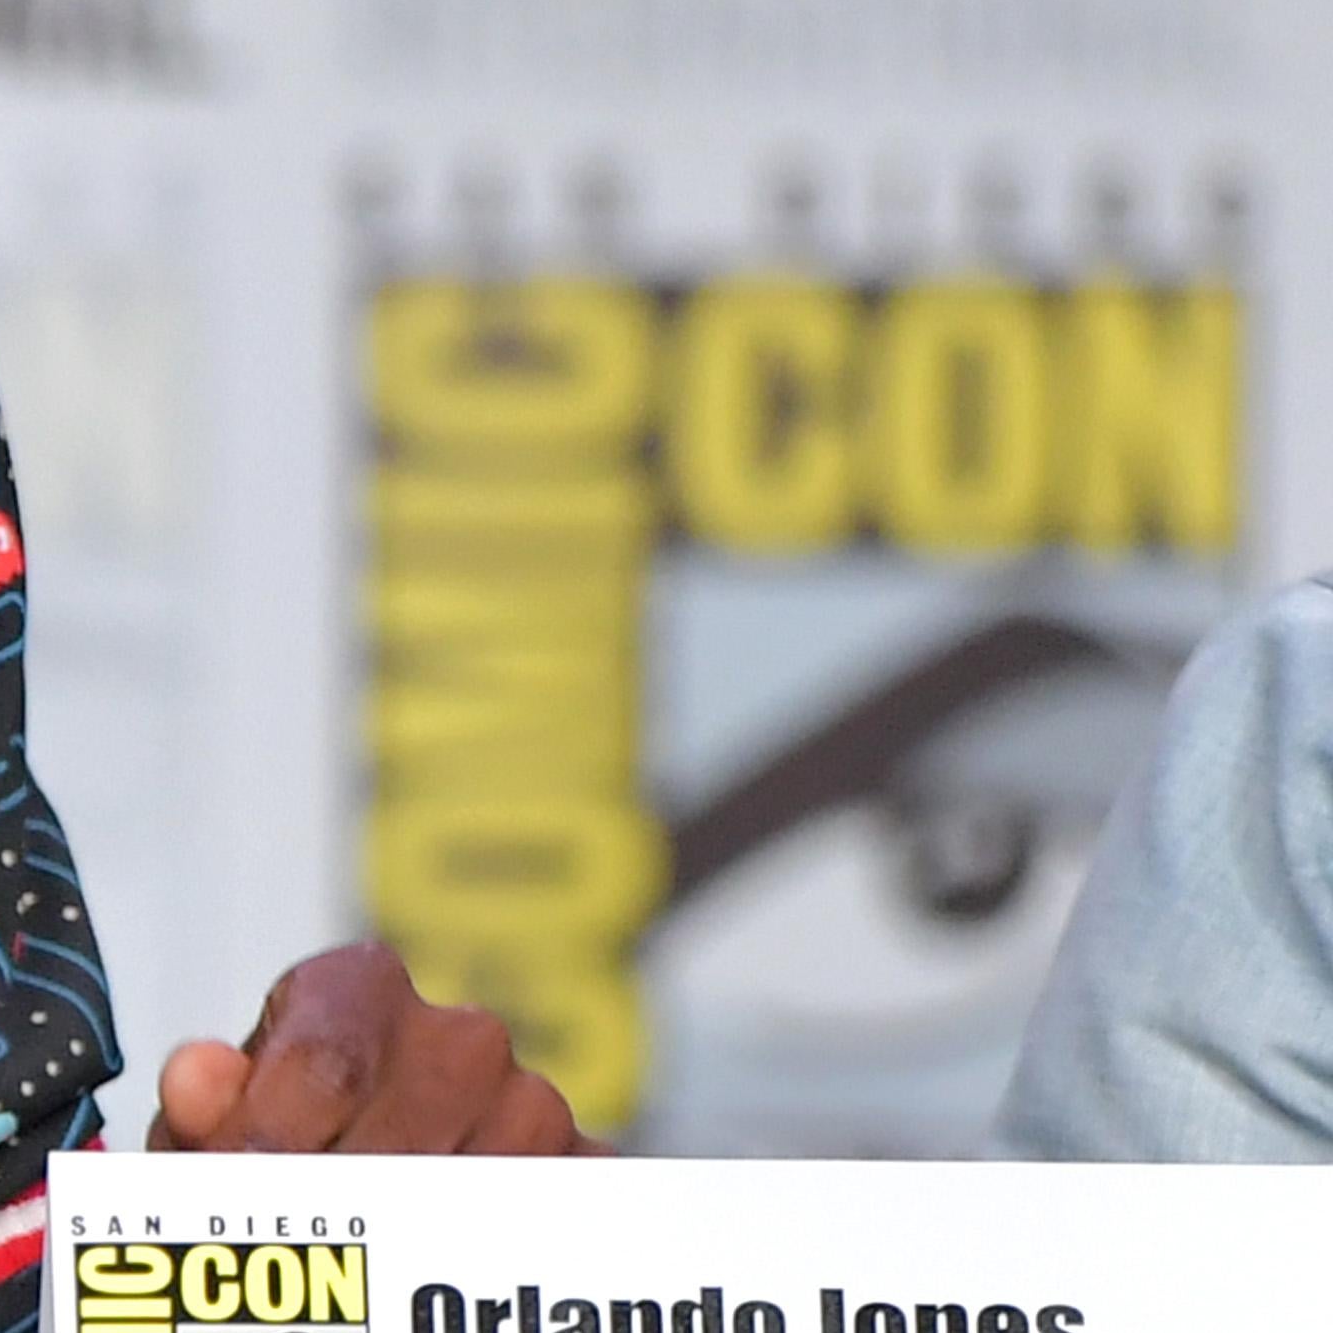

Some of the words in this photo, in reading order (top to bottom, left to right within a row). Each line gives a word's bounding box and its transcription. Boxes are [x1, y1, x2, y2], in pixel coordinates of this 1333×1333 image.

[673, 270, 1241, 558] CON
[71, 1215, 162, 1237] SAN
[209, 1215, 366, 1237] DIEGO
[180, 1242, 367, 1323] CON
